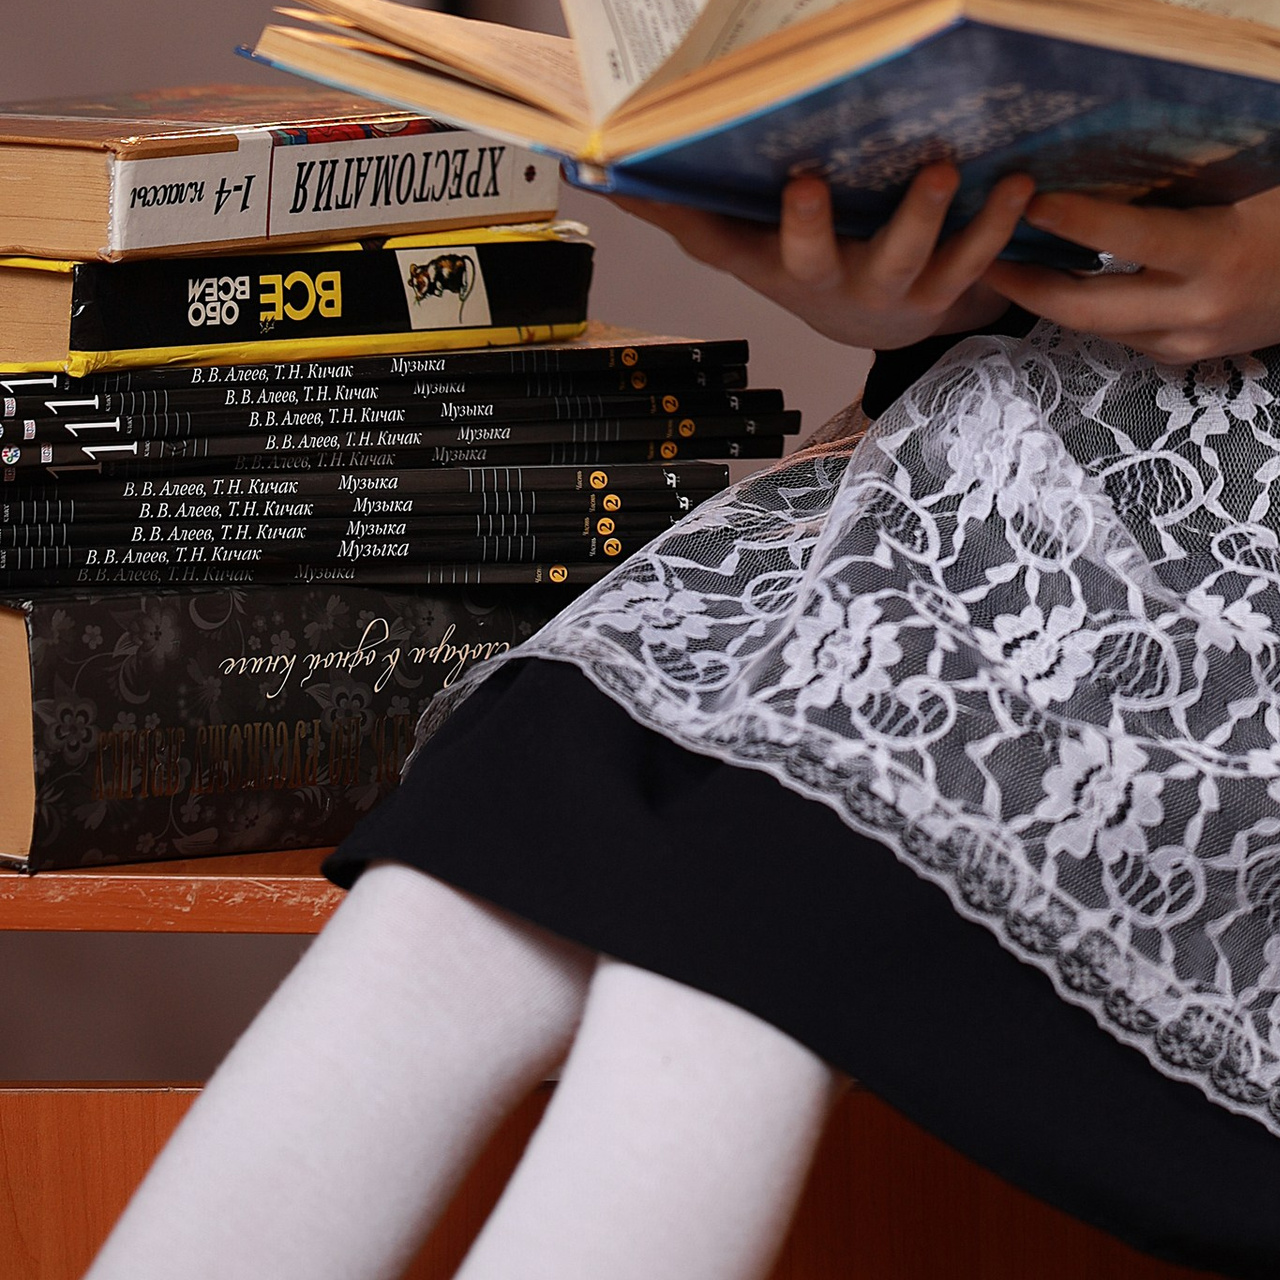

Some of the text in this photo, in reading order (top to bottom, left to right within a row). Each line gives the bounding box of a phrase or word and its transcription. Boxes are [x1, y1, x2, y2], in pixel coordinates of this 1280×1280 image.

[289, 145, 506, 214] ХРЕСТОМАТИЯ
[130, 175, 256, 215] 1-4 классы
[188, 275, 251, 303] ВСЕМ
[187, 300, 240, 327] ОБО
[306, 363, 354, 379] Кичак
[390, 357, 446, 376] Музыка
[0, 374, 58, 394] 1
[334, 384, 379, 401] Кичак
[413, 381, 465, 399] Музыка
[44, 394, 100, 415] 1
[440, 402, 493, 421] Музыка
[360, 407, 406, 423] Кичак
[64, 416, 121, 438] 1
[456, 425, 511, 444] Музыка
[376, 430, 423, 446] Кичак
[81, 441, 139, 461] 1
[431, 446, 488, 464] Музыка
[247, 478, 299, 495] Кичак
[337, 474, 399, 494] Музыка
[262, 500, 314, 516] Кичак
[353, 497, 413, 516] Музыка
[255, 523, 307, 540] Кичак
[345, 520, 406, 539] Музыка
[210, 546, 263, 562] Кичак
[337, 540, 409, 561] Музыка
[294, 564, 356, 584] Музыка
[299, 618, 390, 688] одной
[218, 652, 298, 700] книге
